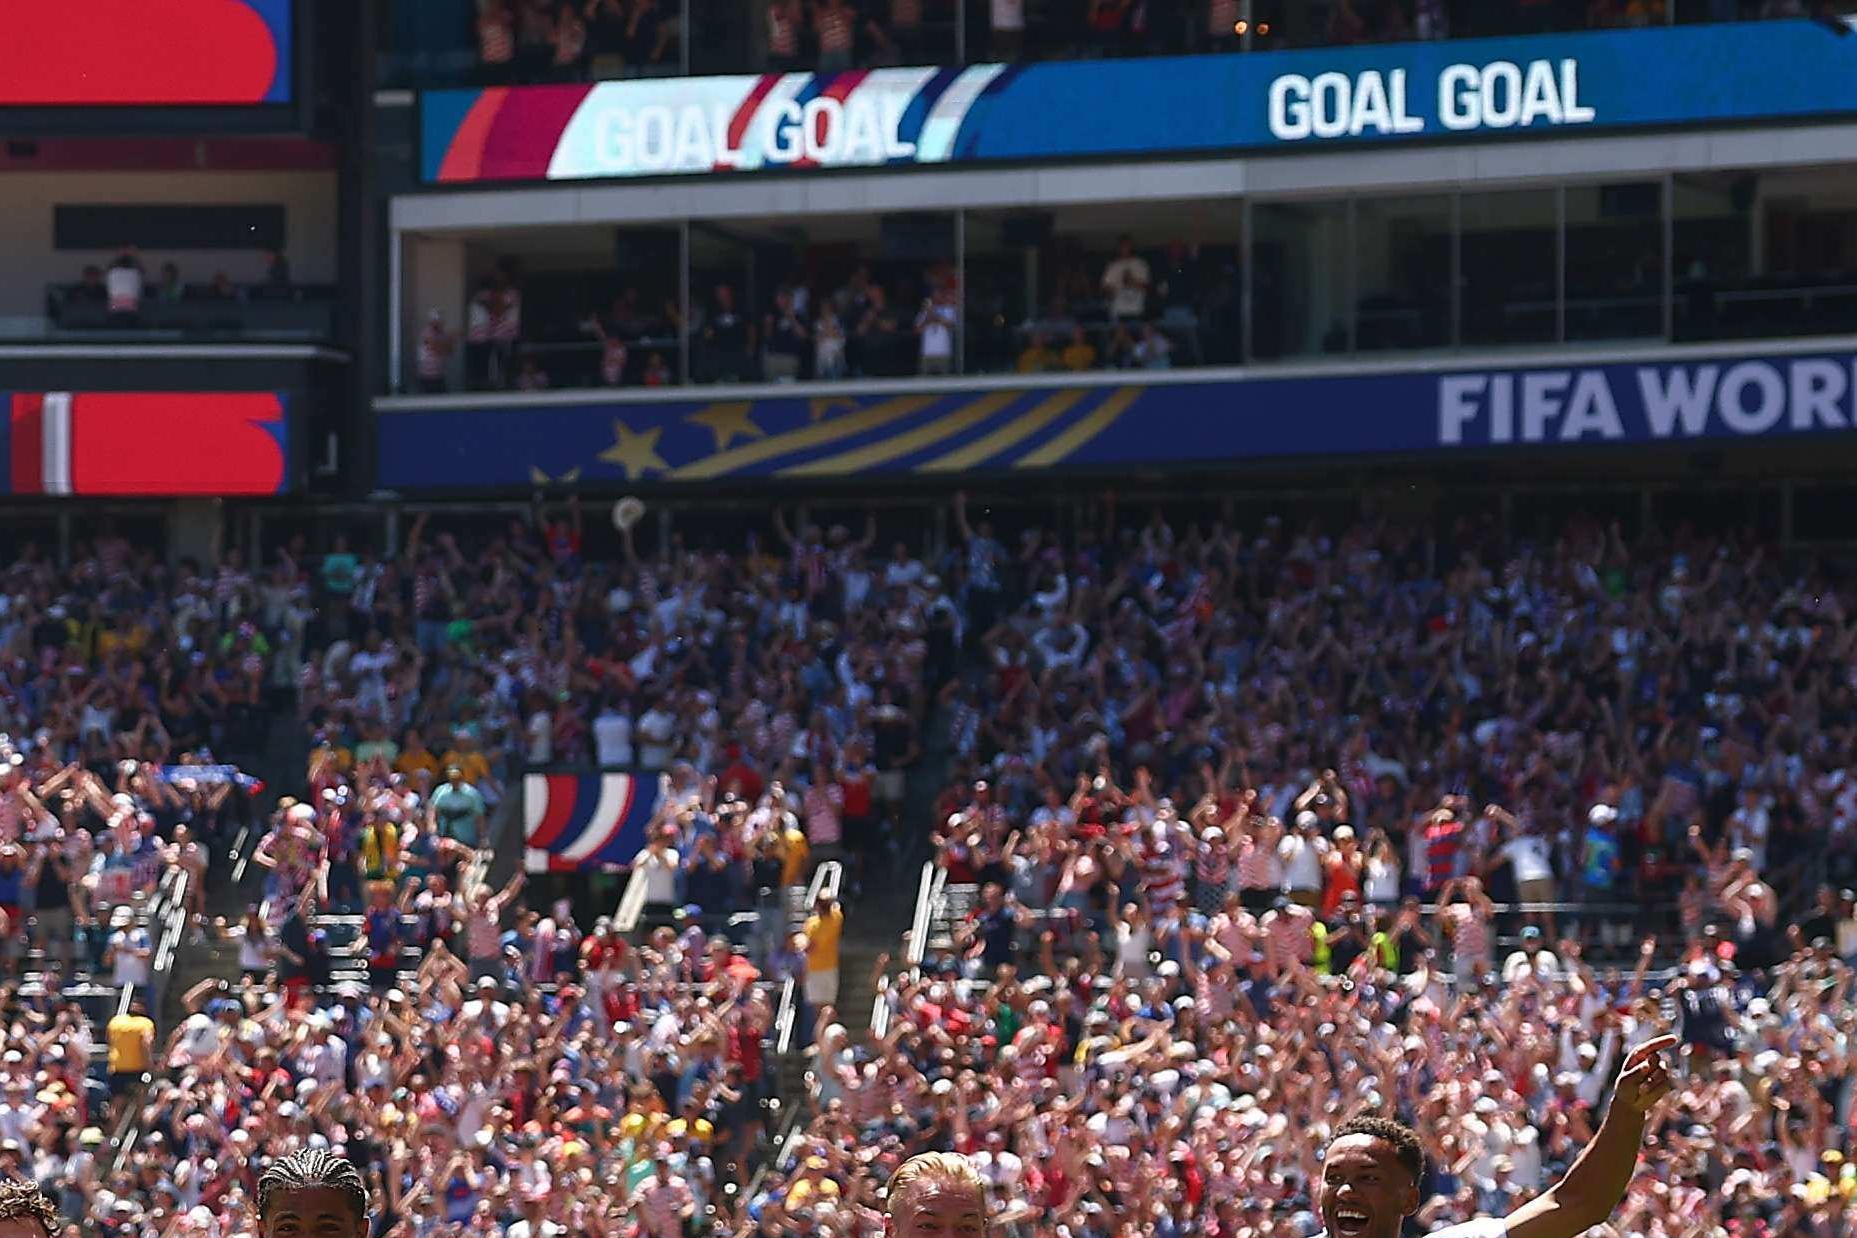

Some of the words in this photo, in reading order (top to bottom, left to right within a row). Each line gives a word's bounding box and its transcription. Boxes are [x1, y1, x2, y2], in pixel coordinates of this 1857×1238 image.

[595, 104, 743, 167] GOAL
[765, 94, 916, 162] GOAL
[1269, 69, 1424, 140] GOAL
[1439, 59, 1596, 131] GOAL
[1439, 369, 1626, 445] FIFA
[1637, 358, 1857, 439] WOR
